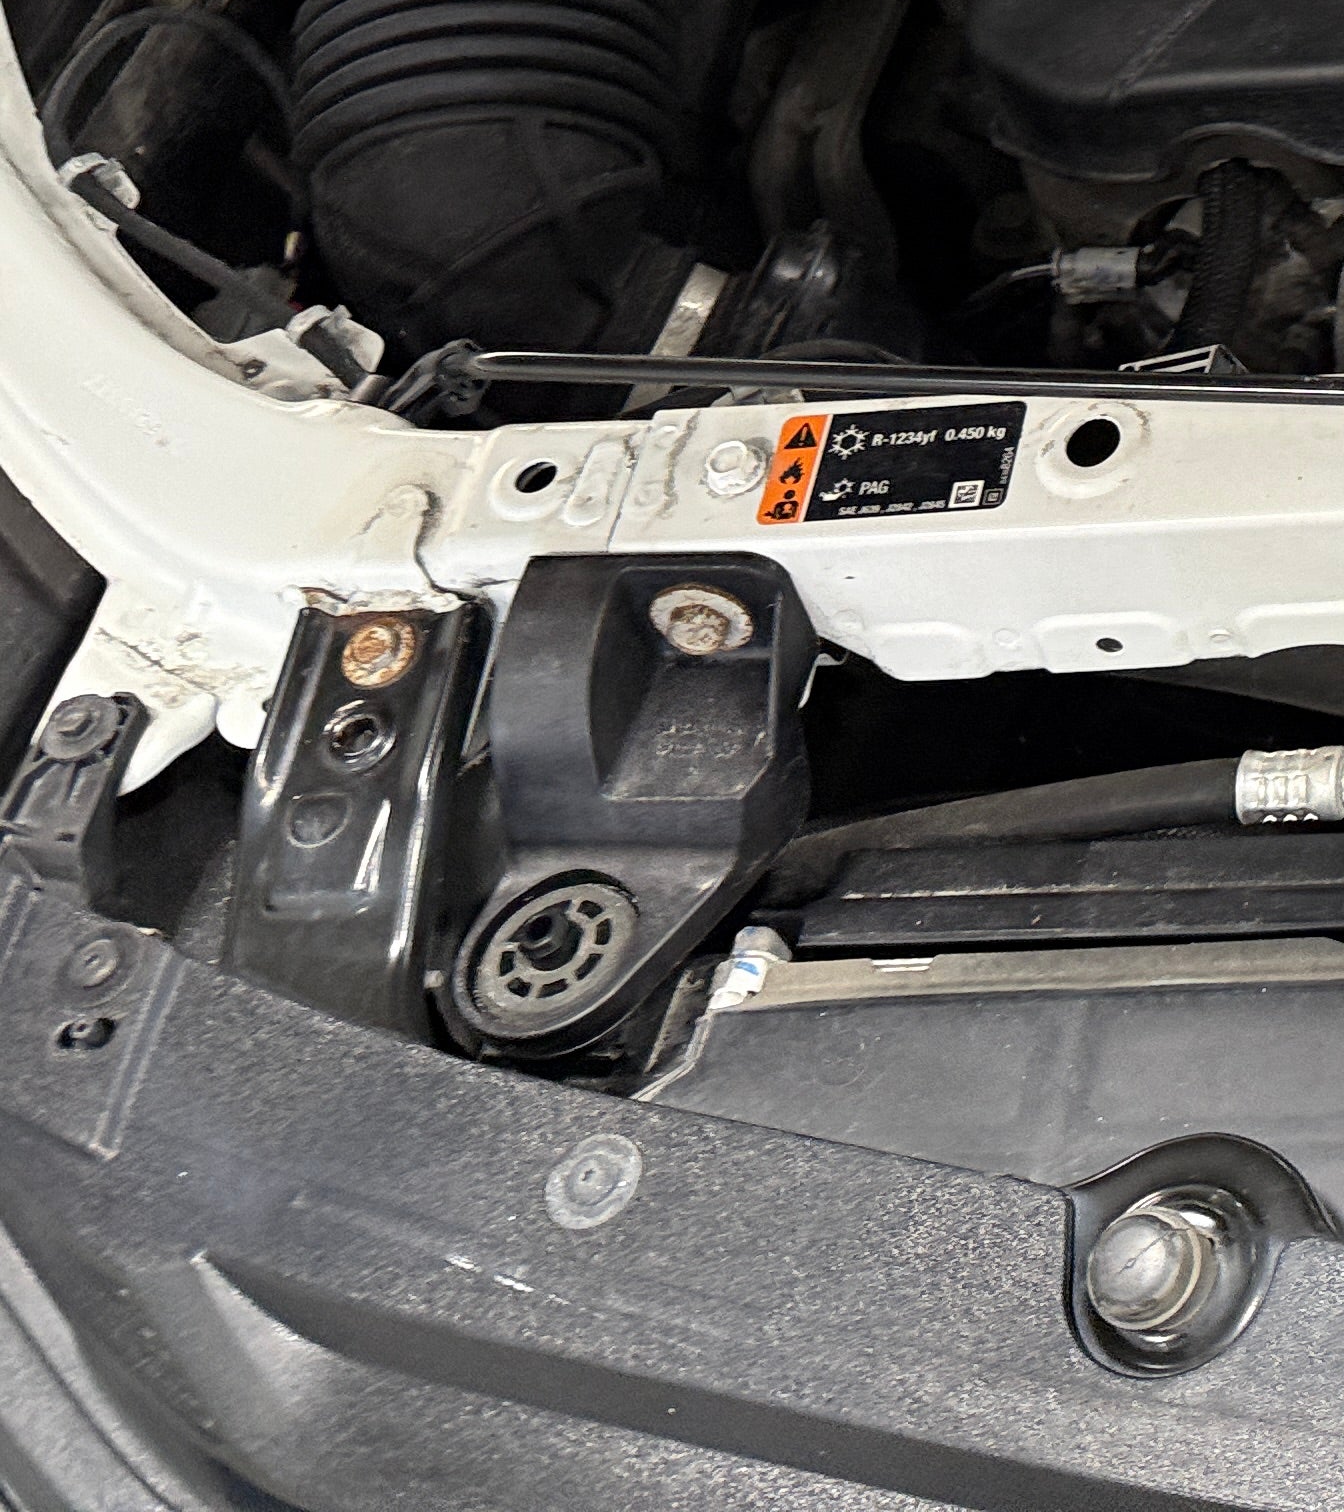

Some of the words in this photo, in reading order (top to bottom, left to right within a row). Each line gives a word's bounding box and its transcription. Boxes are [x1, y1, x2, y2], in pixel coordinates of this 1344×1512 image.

[871, 429, 938, 447] R-1234yf
[944, 426, 985, 442] 0.450
[986, 425, 1007, 439] kg
[858, 480, 891, 496] PAG
